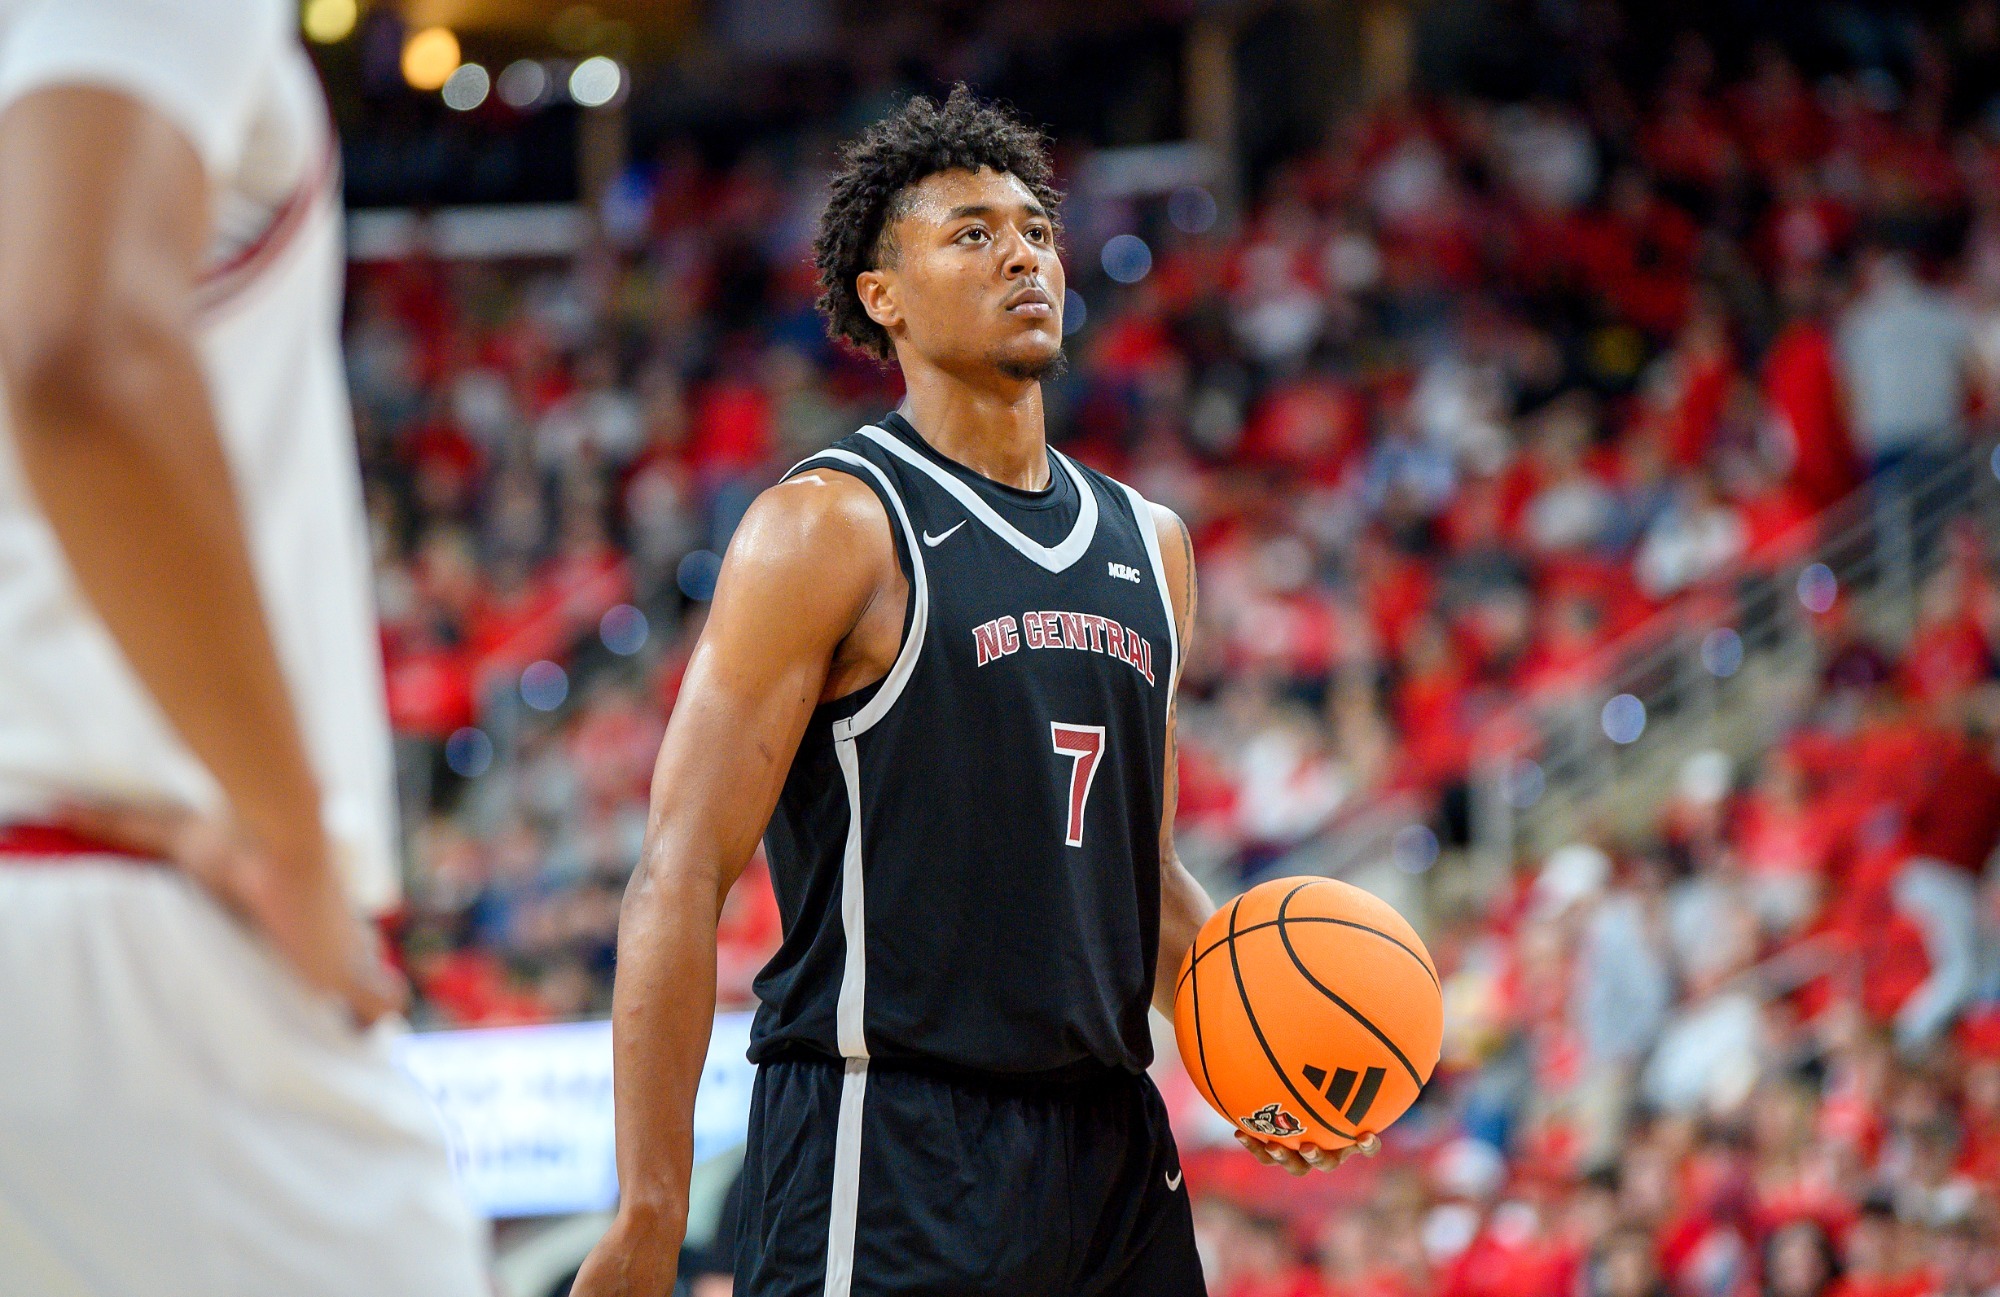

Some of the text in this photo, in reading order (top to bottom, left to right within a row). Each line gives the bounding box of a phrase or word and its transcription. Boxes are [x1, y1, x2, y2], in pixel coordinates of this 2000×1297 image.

[972, 611, 1155, 687] NC CENTRAL
[1050, 721, 1106, 848] 7
